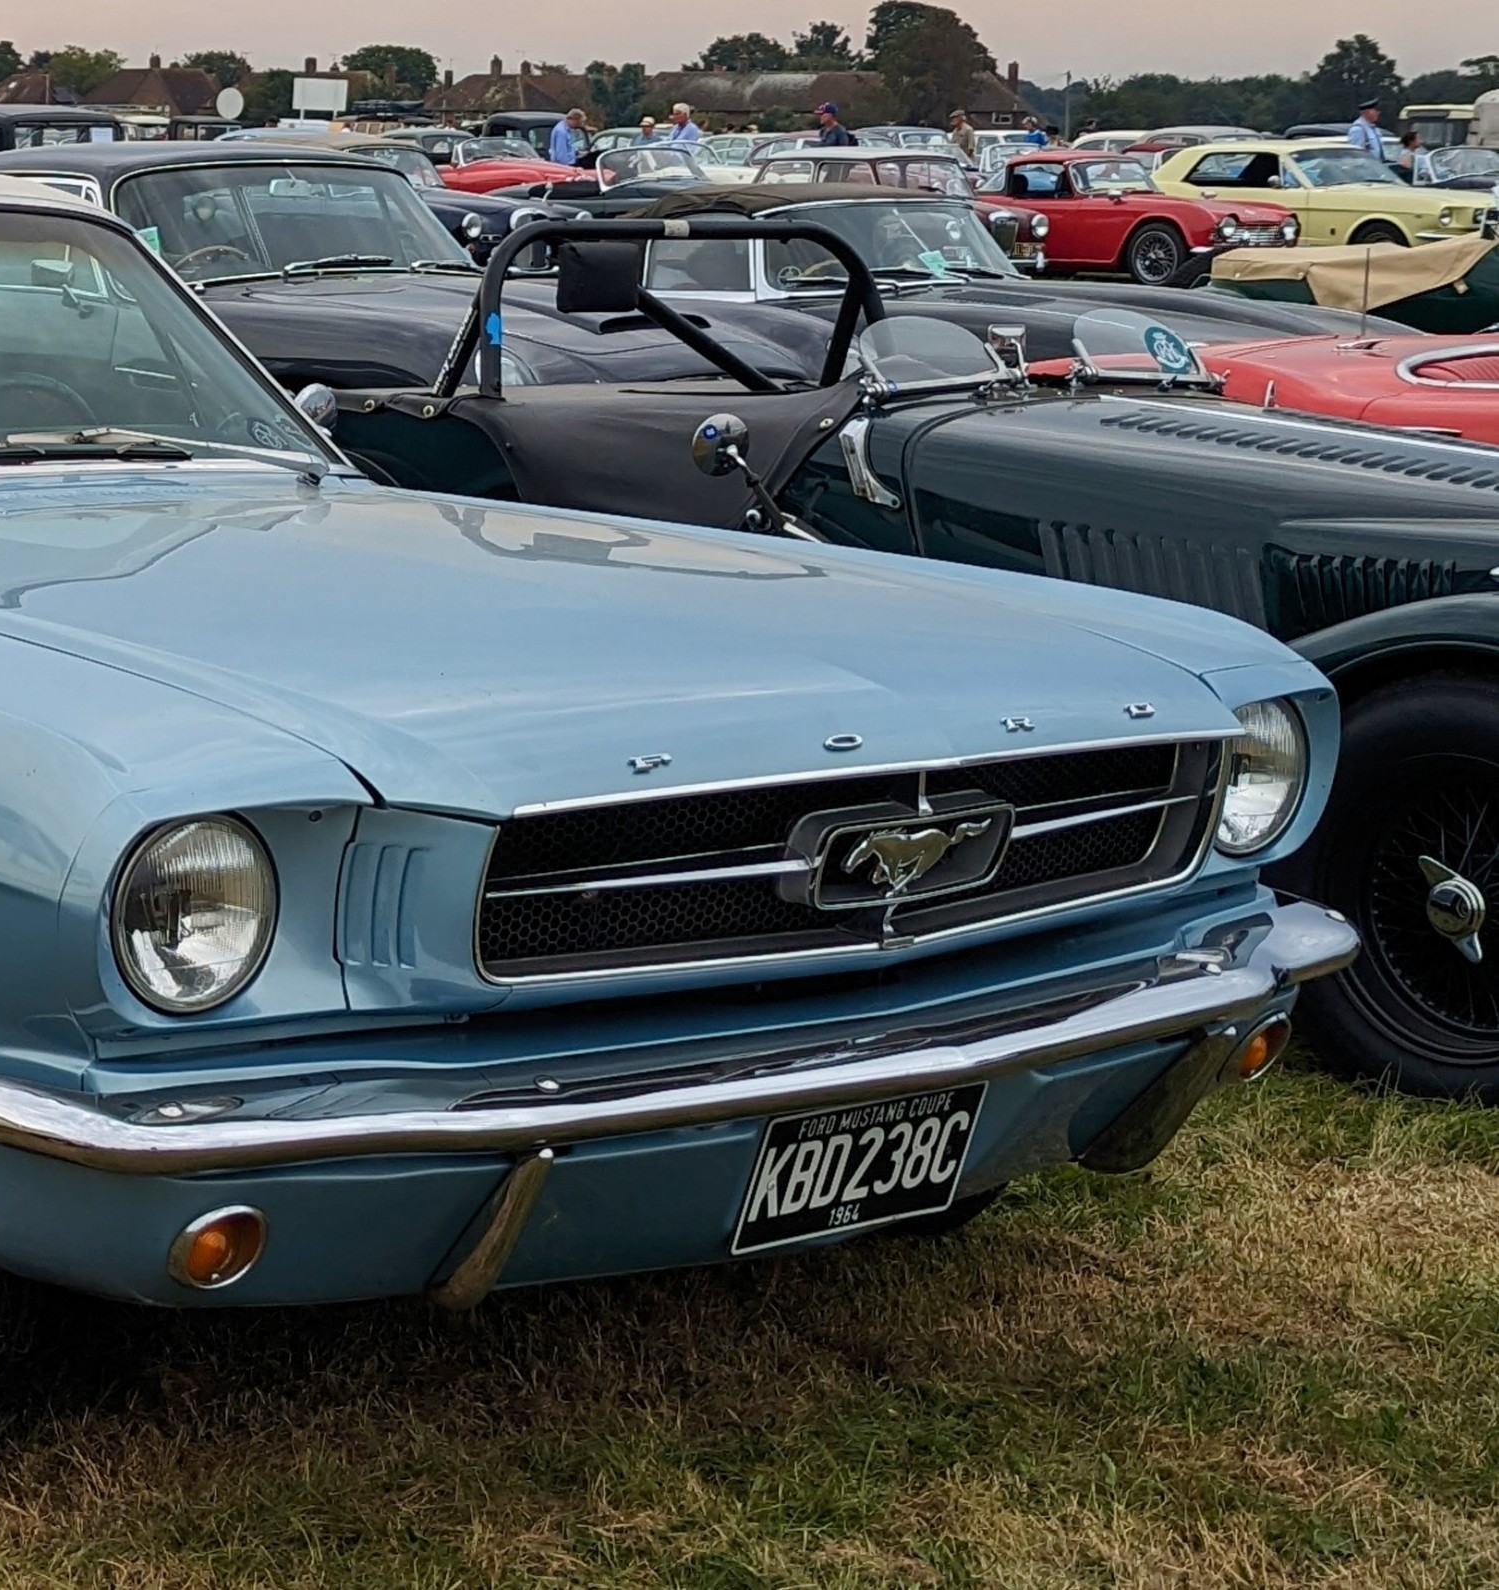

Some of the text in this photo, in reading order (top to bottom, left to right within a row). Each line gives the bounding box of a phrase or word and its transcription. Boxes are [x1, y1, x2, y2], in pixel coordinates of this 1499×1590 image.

[627, 702, 1156, 773] FORD
[798, 1091, 955, 1140] FORD MUSTANG COUPE
[828, 1203, 860, 1227] 1964
